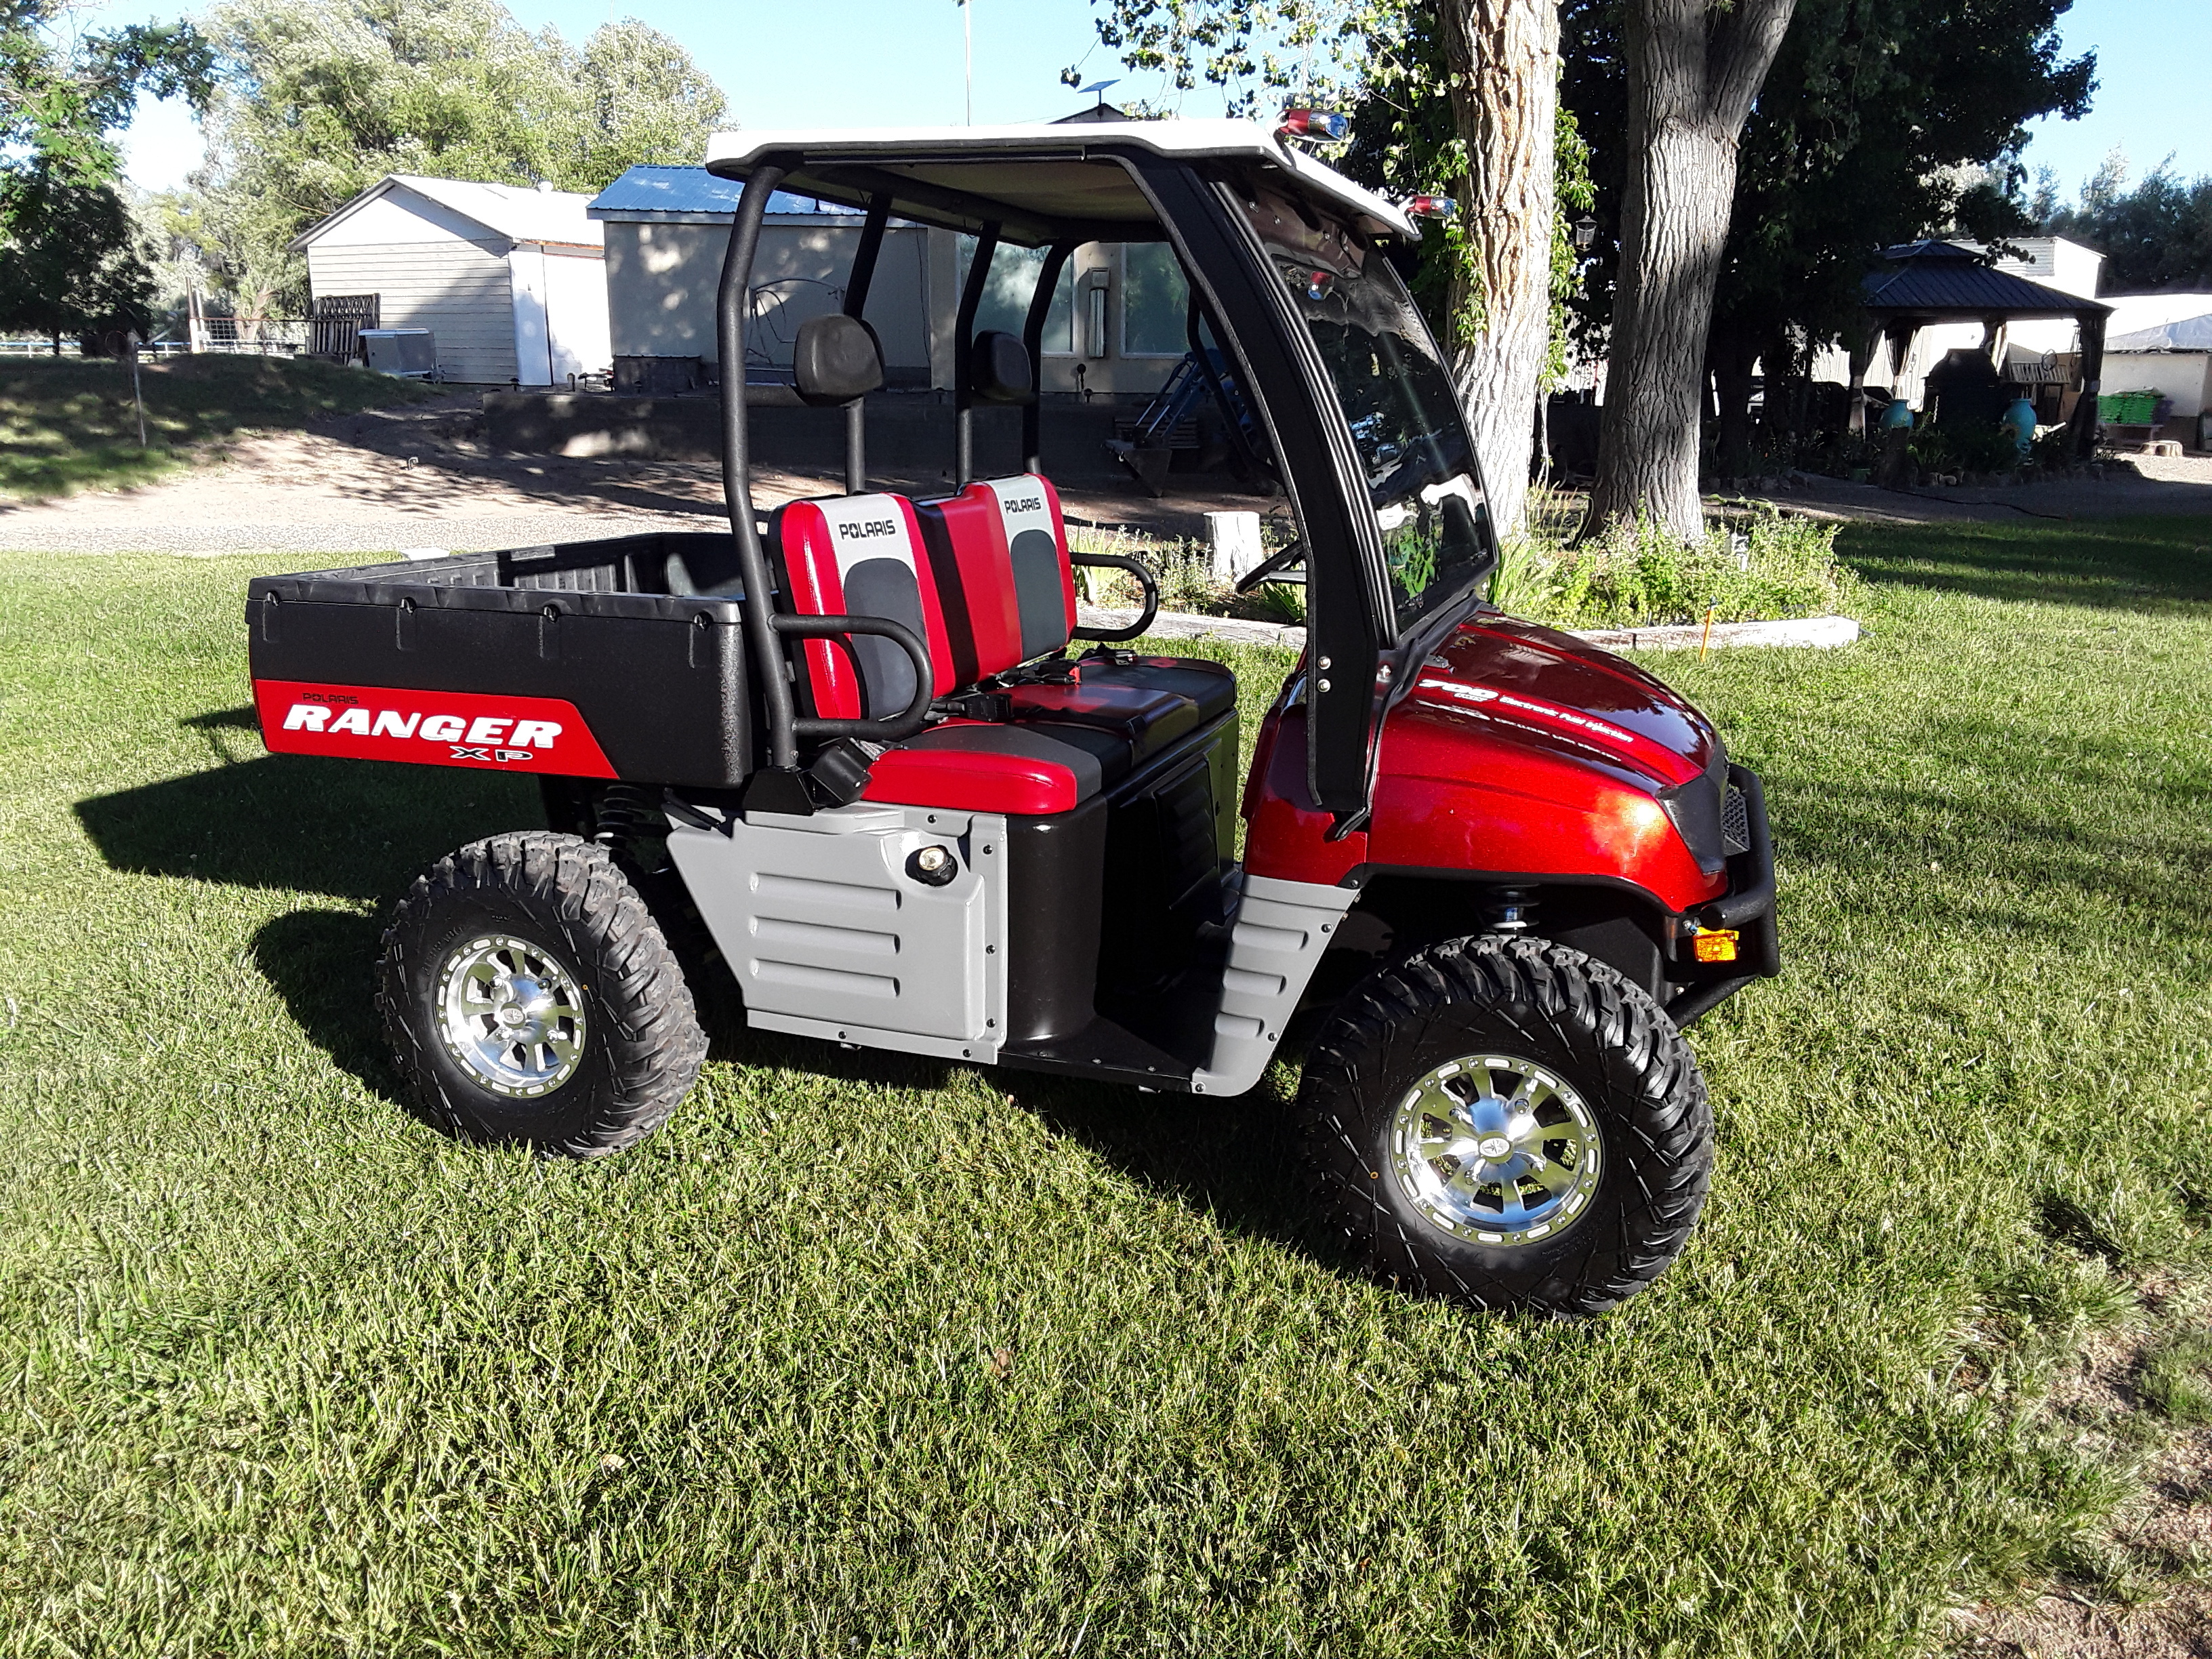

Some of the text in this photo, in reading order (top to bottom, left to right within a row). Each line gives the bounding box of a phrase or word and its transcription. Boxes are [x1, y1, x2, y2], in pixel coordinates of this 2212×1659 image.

[1004, 497, 1042, 515] POLARIS
[838, 519, 896, 540] POLARIS
[1418, 678, 1499, 699] 700
[302, 693, 359, 705] POLARIS
[283, 703, 563, 750] RANGER
[449, 745, 533, 762] XP
